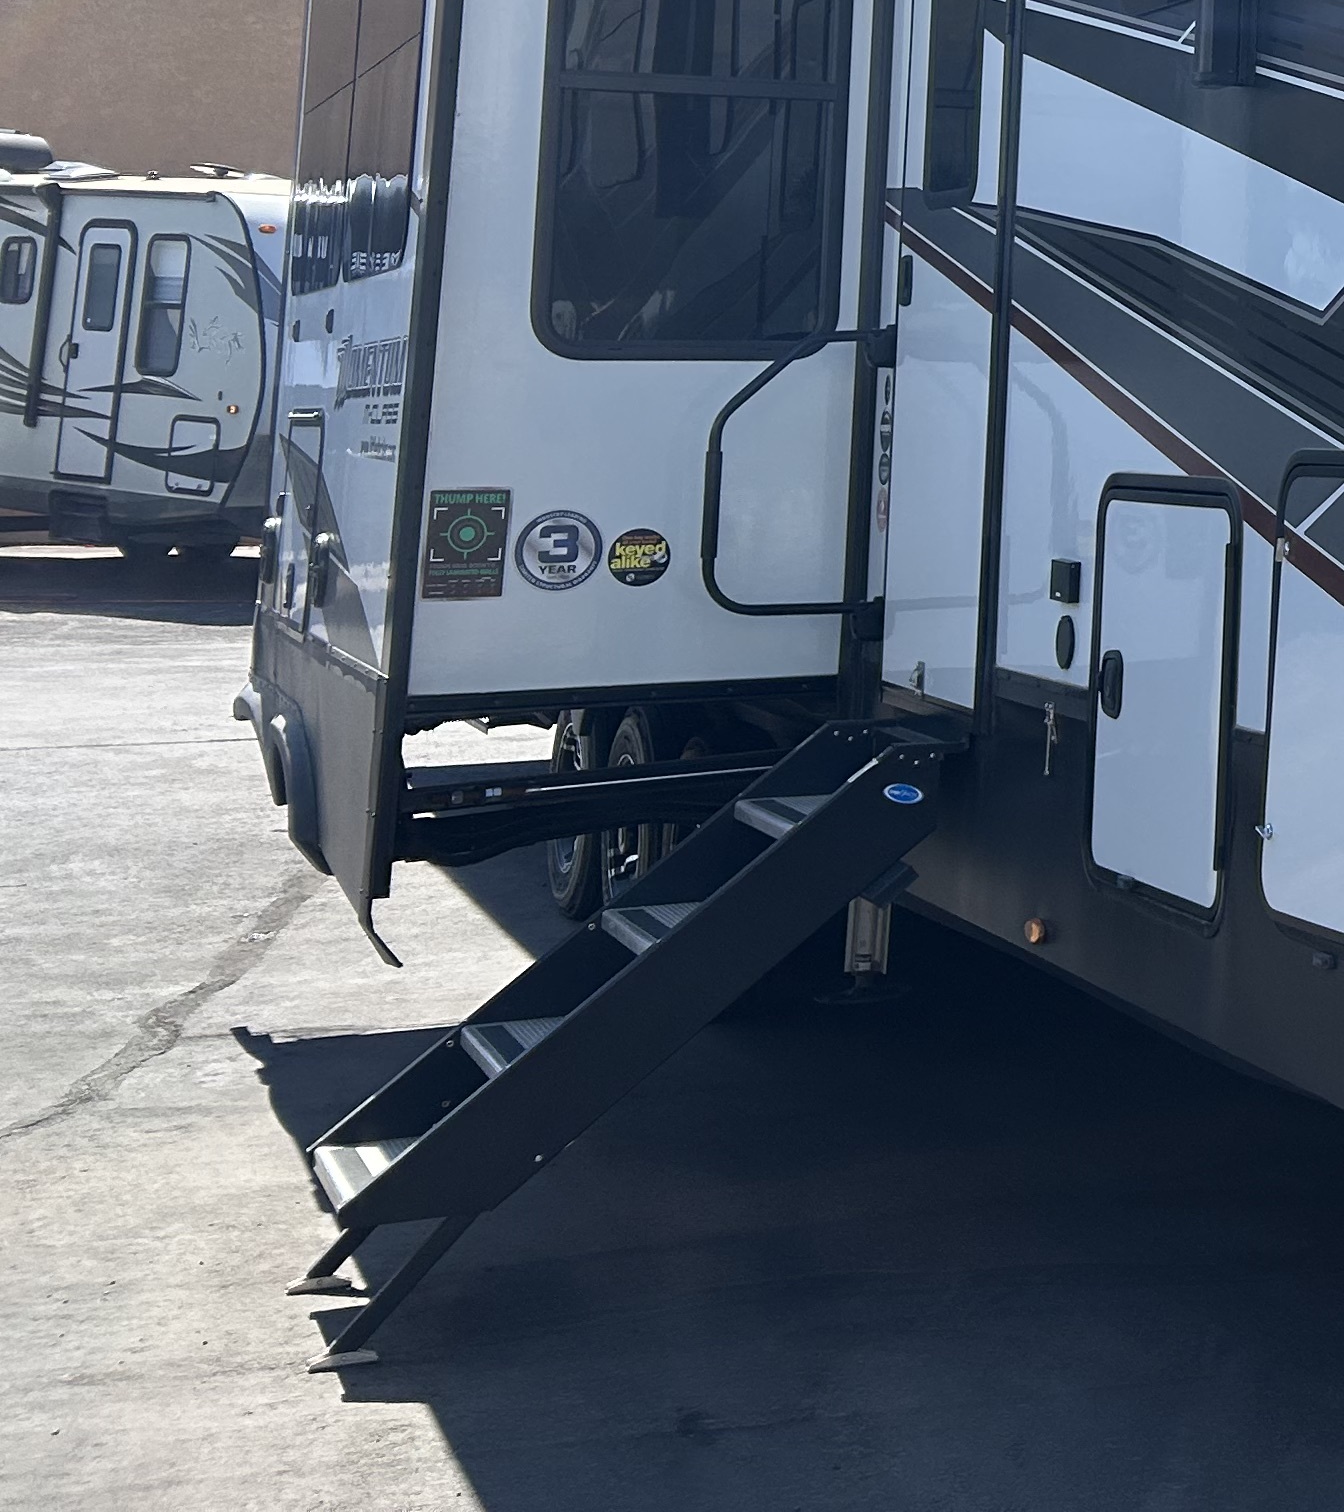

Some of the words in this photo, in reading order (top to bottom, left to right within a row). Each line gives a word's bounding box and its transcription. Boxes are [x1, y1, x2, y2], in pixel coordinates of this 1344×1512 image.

[435, 493, 474, 504] THUMP
[475, 493, 506, 504] HERE!
[537, 525, 579, 563] 3
[615, 540, 666, 558] keyed
[610, 555, 651, 569] alike
[538, 565, 577, 575] YEAR
